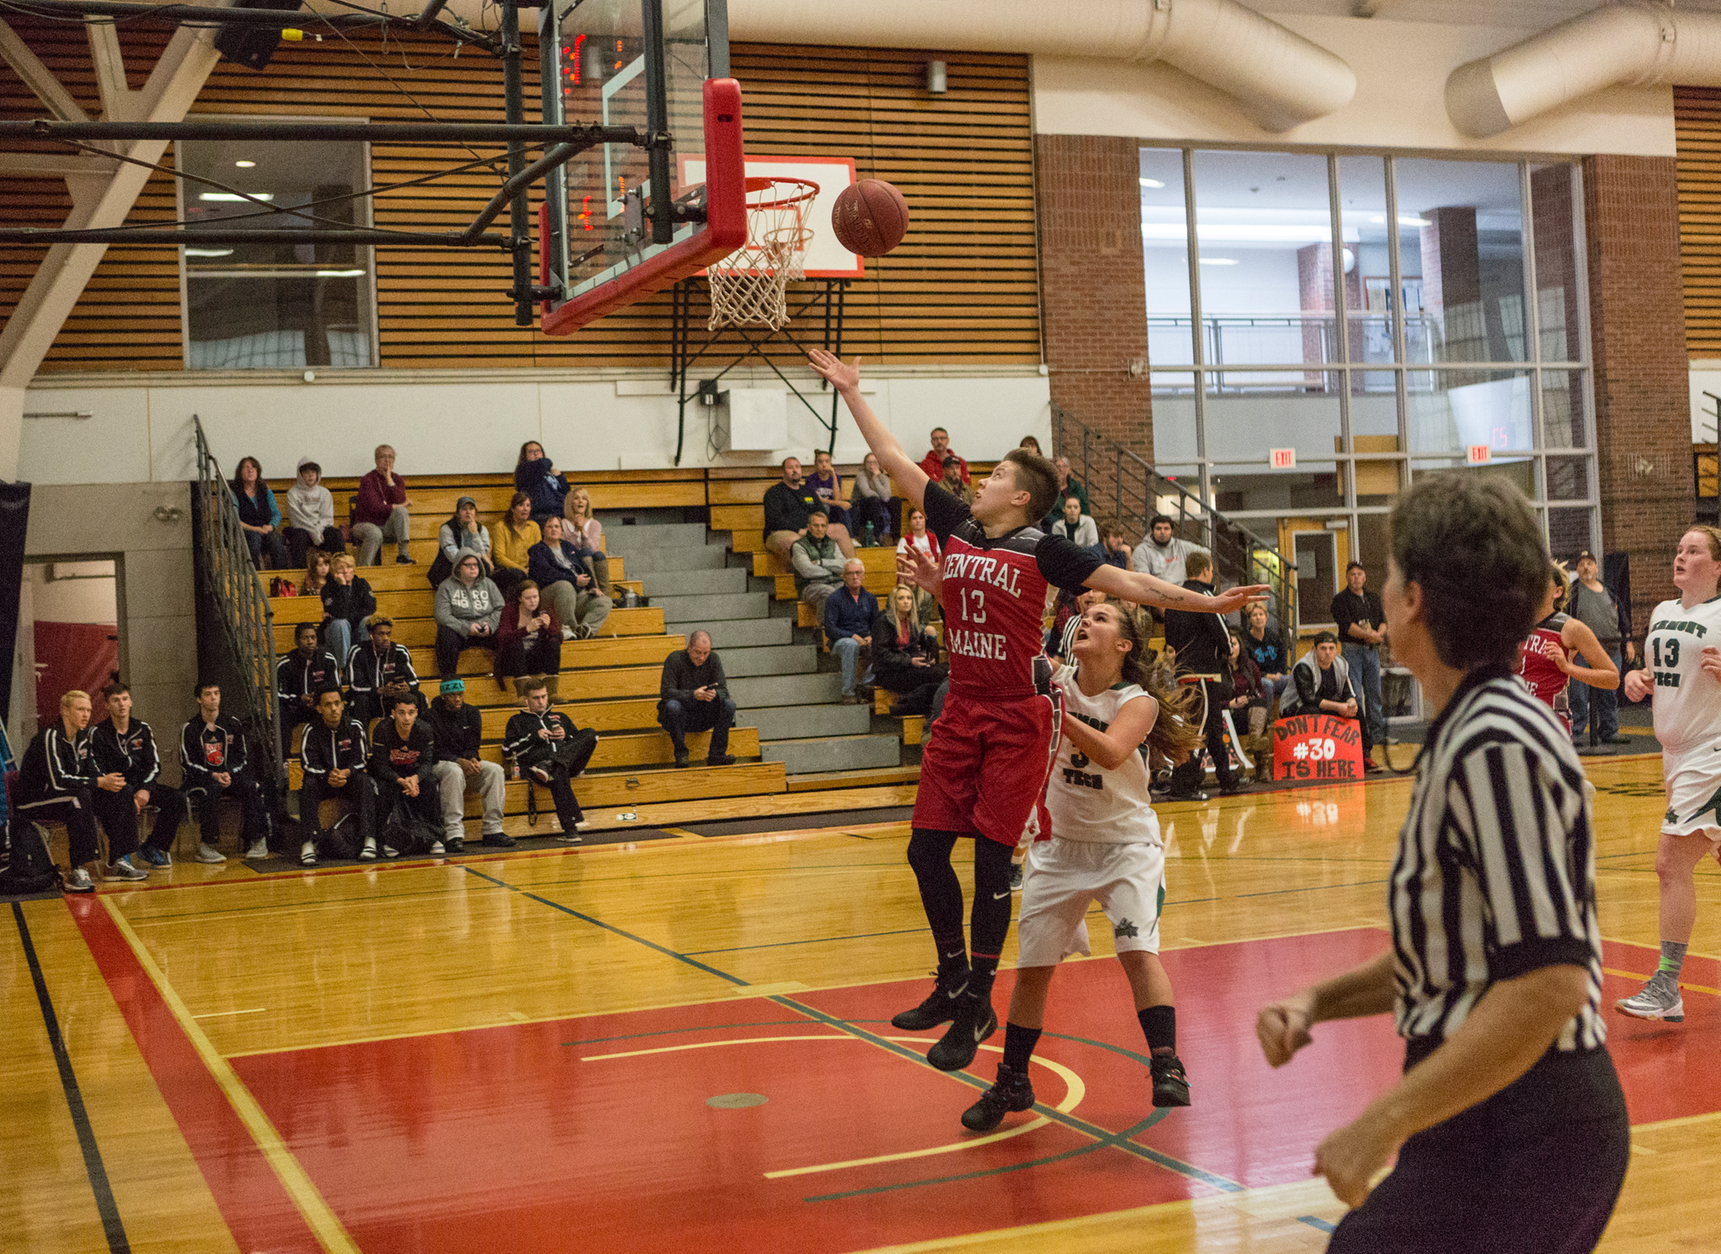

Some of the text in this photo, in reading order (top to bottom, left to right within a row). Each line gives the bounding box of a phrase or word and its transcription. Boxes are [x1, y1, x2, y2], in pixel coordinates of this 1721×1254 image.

[1275, 450, 1291, 467] EXIT
[1472, 445, 1487, 462] EXIT
[943, 553, 1021, 599] CENTRAL
[453, 589, 489, 600] AERO
[960, 587, 986, 624] 13
[949, 628, 1006, 661] MAINE
[1652, 637, 1680, 668] 13
[1323, 716, 1360, 747] FEAR
[1293, 738, 1335, 760] #30
[1063, 767, 1103, 790] TECH
[1282, 759, 1356, 779] IS HERE
